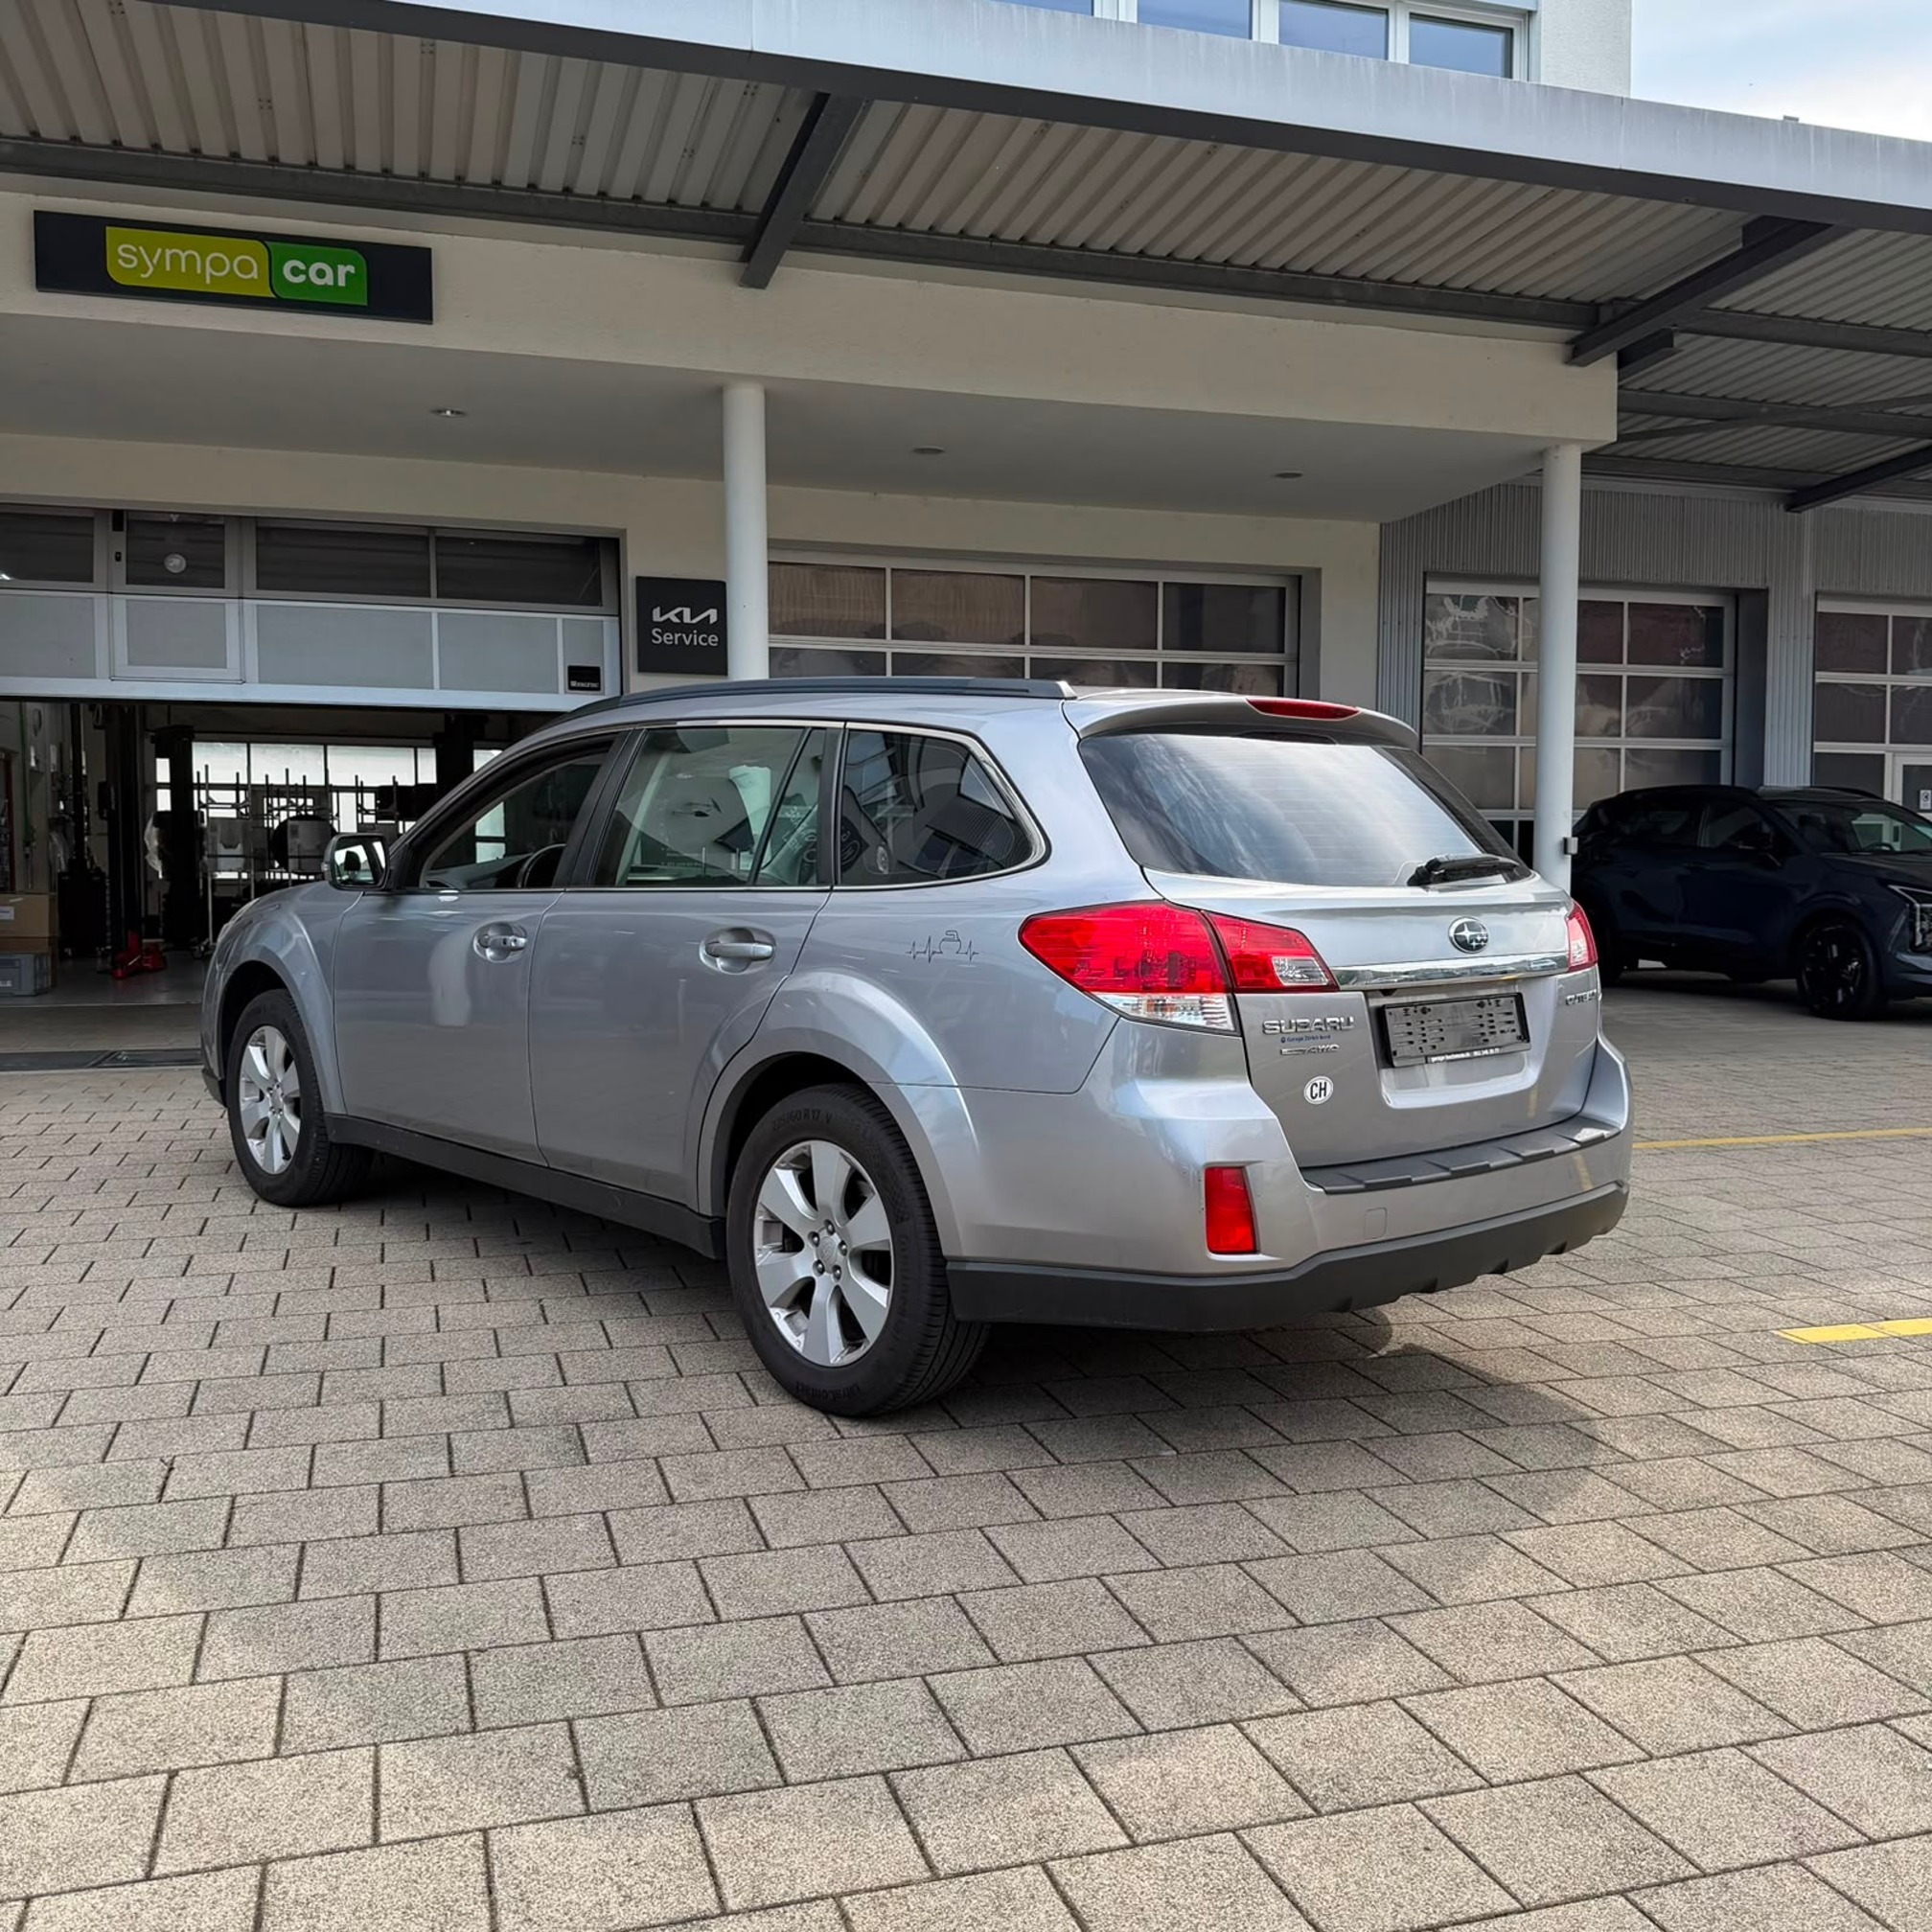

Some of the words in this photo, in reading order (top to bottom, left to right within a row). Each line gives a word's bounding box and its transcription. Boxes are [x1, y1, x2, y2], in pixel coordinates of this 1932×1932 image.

[117, 243, 259, 285] sympa
[283, 259, 356, 287] car
[651, 628, 719, 647] Service
[1262, 1016, 1354, 1035] SUBARU
[1309, 1081, 1327, 1100] CH
